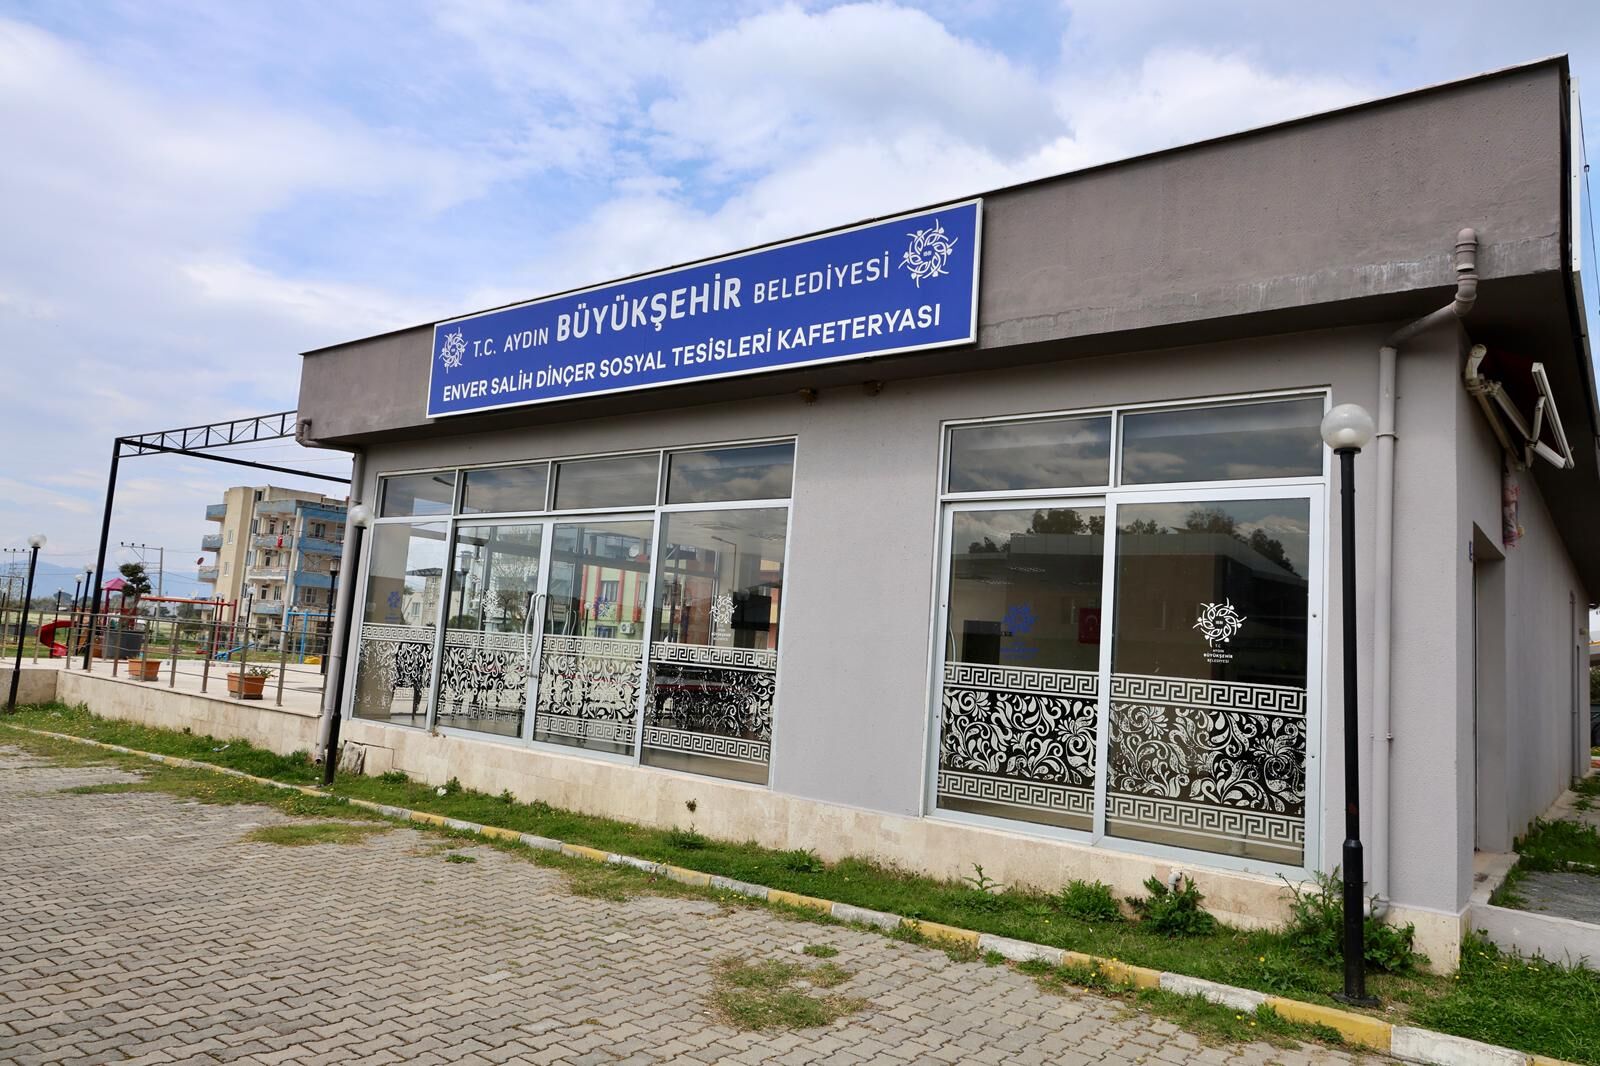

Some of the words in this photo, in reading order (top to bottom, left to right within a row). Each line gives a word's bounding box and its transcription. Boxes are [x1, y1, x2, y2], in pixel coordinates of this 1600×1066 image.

[442, 380, 488, 402] ENVER
[490, 370, 533, 395] SALİH
[535, 362, 596, 388] DİNÇER
[599, 351, 667, 378] SOSYAL
[671, 328, 772, 367] TESİSLERİ
[777, 304, 941, 351] KAFETERYASI
[473, 339, 497, 358] T.C.
[503, 328, 549, 353] AYDIN
[556, 272, 742, 342] BÜYÜKŞEHİR
[753, 250, 889, 304] BELEDİYESİ
